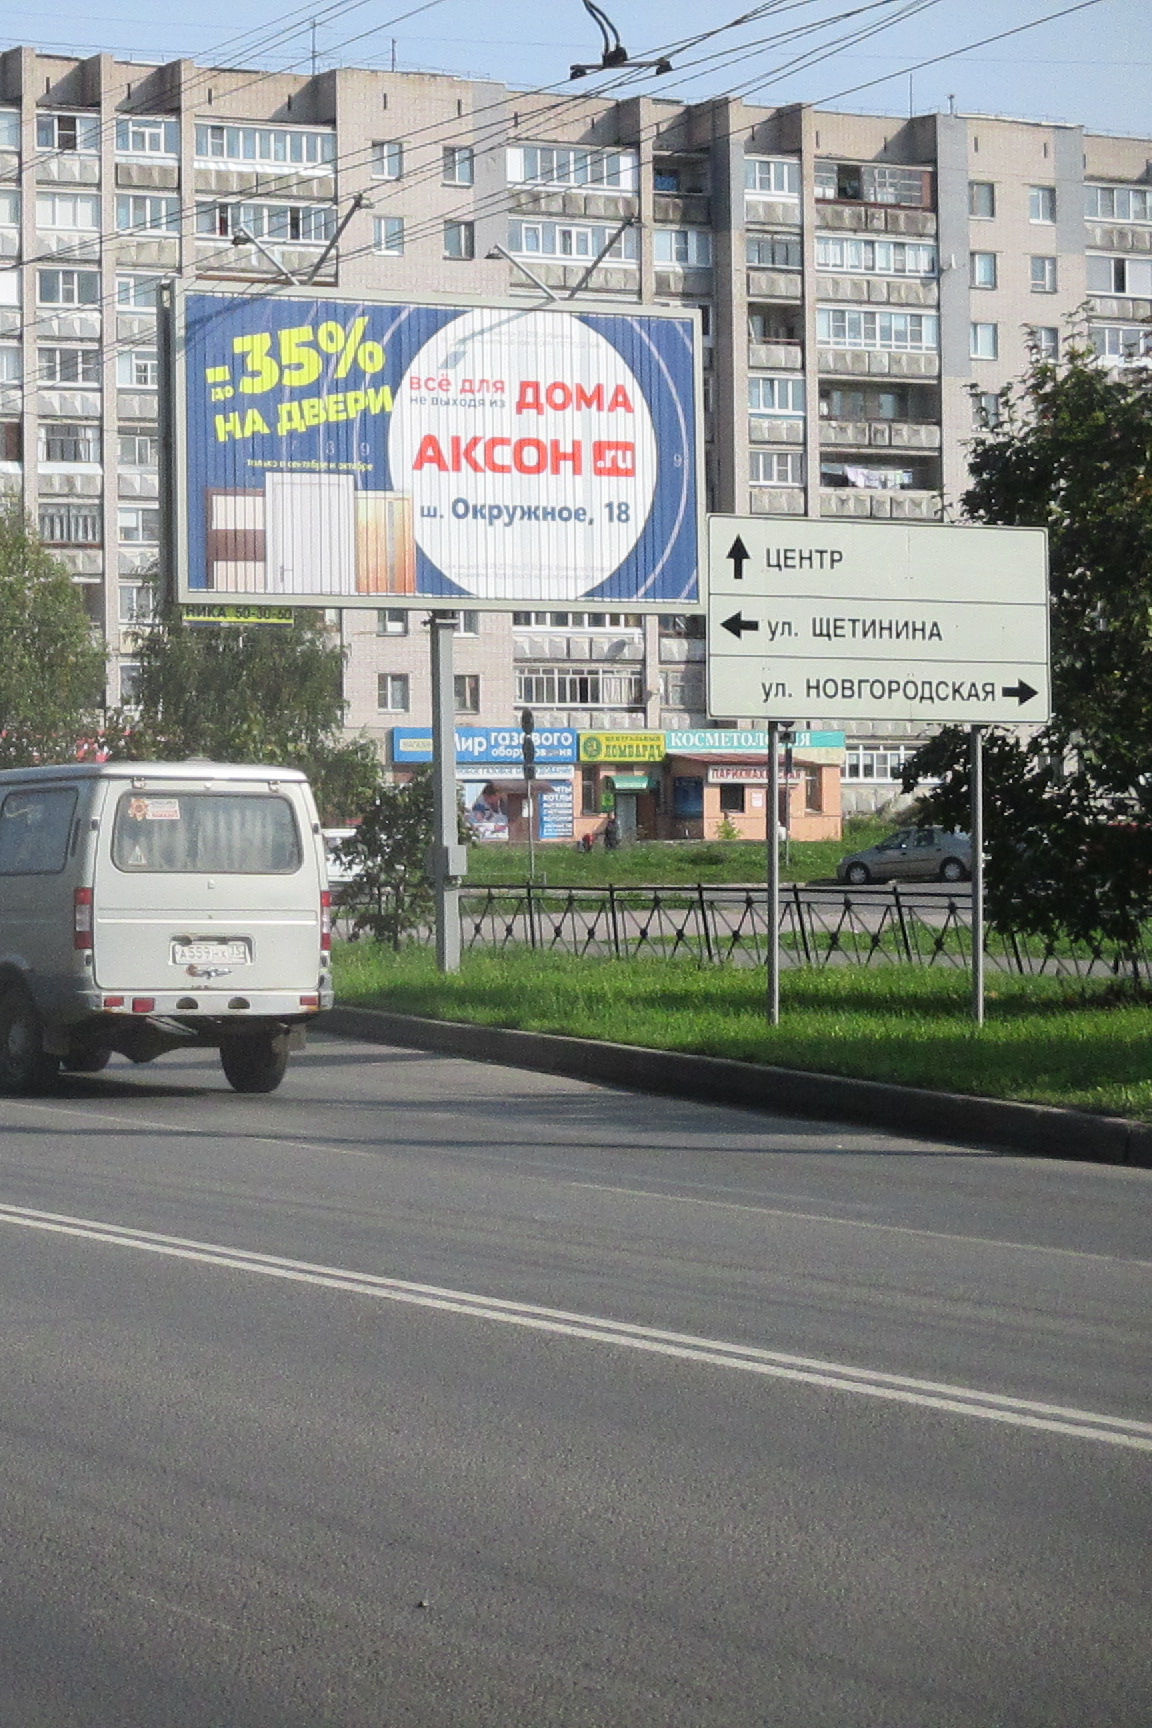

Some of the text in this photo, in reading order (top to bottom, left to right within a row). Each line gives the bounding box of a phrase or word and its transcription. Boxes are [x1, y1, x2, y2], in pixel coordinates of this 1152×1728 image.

[205, 316, 386, 394] -35%
[211, 385, 235, 402] до
[409, 373, 506, 395] всё для
[516, 380, 635, 415] ДОМА
[215, 385, 394, 443] НА ДВЕРИ
[412, 433, 583, 476] АКСОН
[420, 496, 631, 527] ш. Окружное, 18
[765, 547, 844, 571] ЦЕНТР
[767, 616, 943, 642] ул. ЩЕТИНИНА
[761, 677, 996, 704] ул. НОВГОРОДСКАЯ
[490, 731, 573, 746] газвого
[670, 731, 812, 748] КОСМЕТОЛЯ
